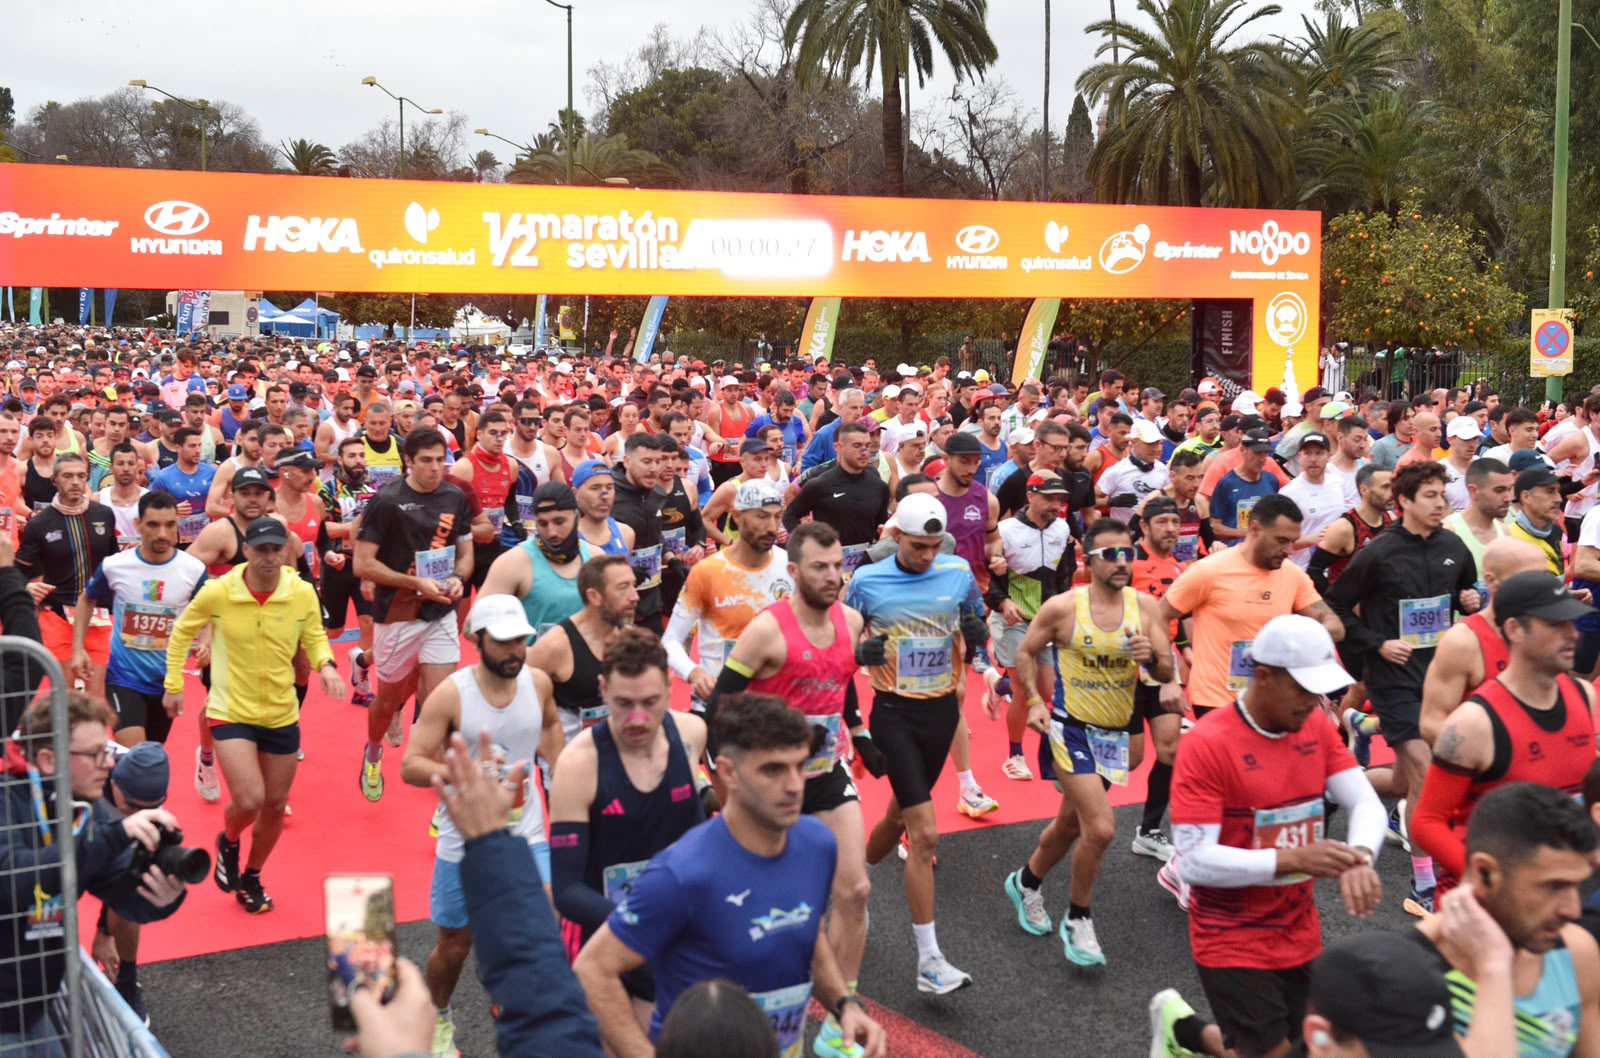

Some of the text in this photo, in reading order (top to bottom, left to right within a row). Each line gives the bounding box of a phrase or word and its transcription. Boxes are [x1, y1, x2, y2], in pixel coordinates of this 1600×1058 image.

[0, 211, 119, 238] Sprinter
[243, 215, 361, 253] HOKA
[527, 210, 679, 242] maratón
[131, 238, 223, 255] HYUNDAI
[841, 230, 931, 262] HOKA
[1153, 241, 1223, 261] Sprinter
[947, 256, 1008, 269] HYUNDAI
[1221, 310, 1233, 355] FINISH
[132, 614, 166, 632] 1375
[1408, 609, 1442, 628] 3691
[907, 650, 945, 668] 1722
[1274, 821, 1308, 849] 431
